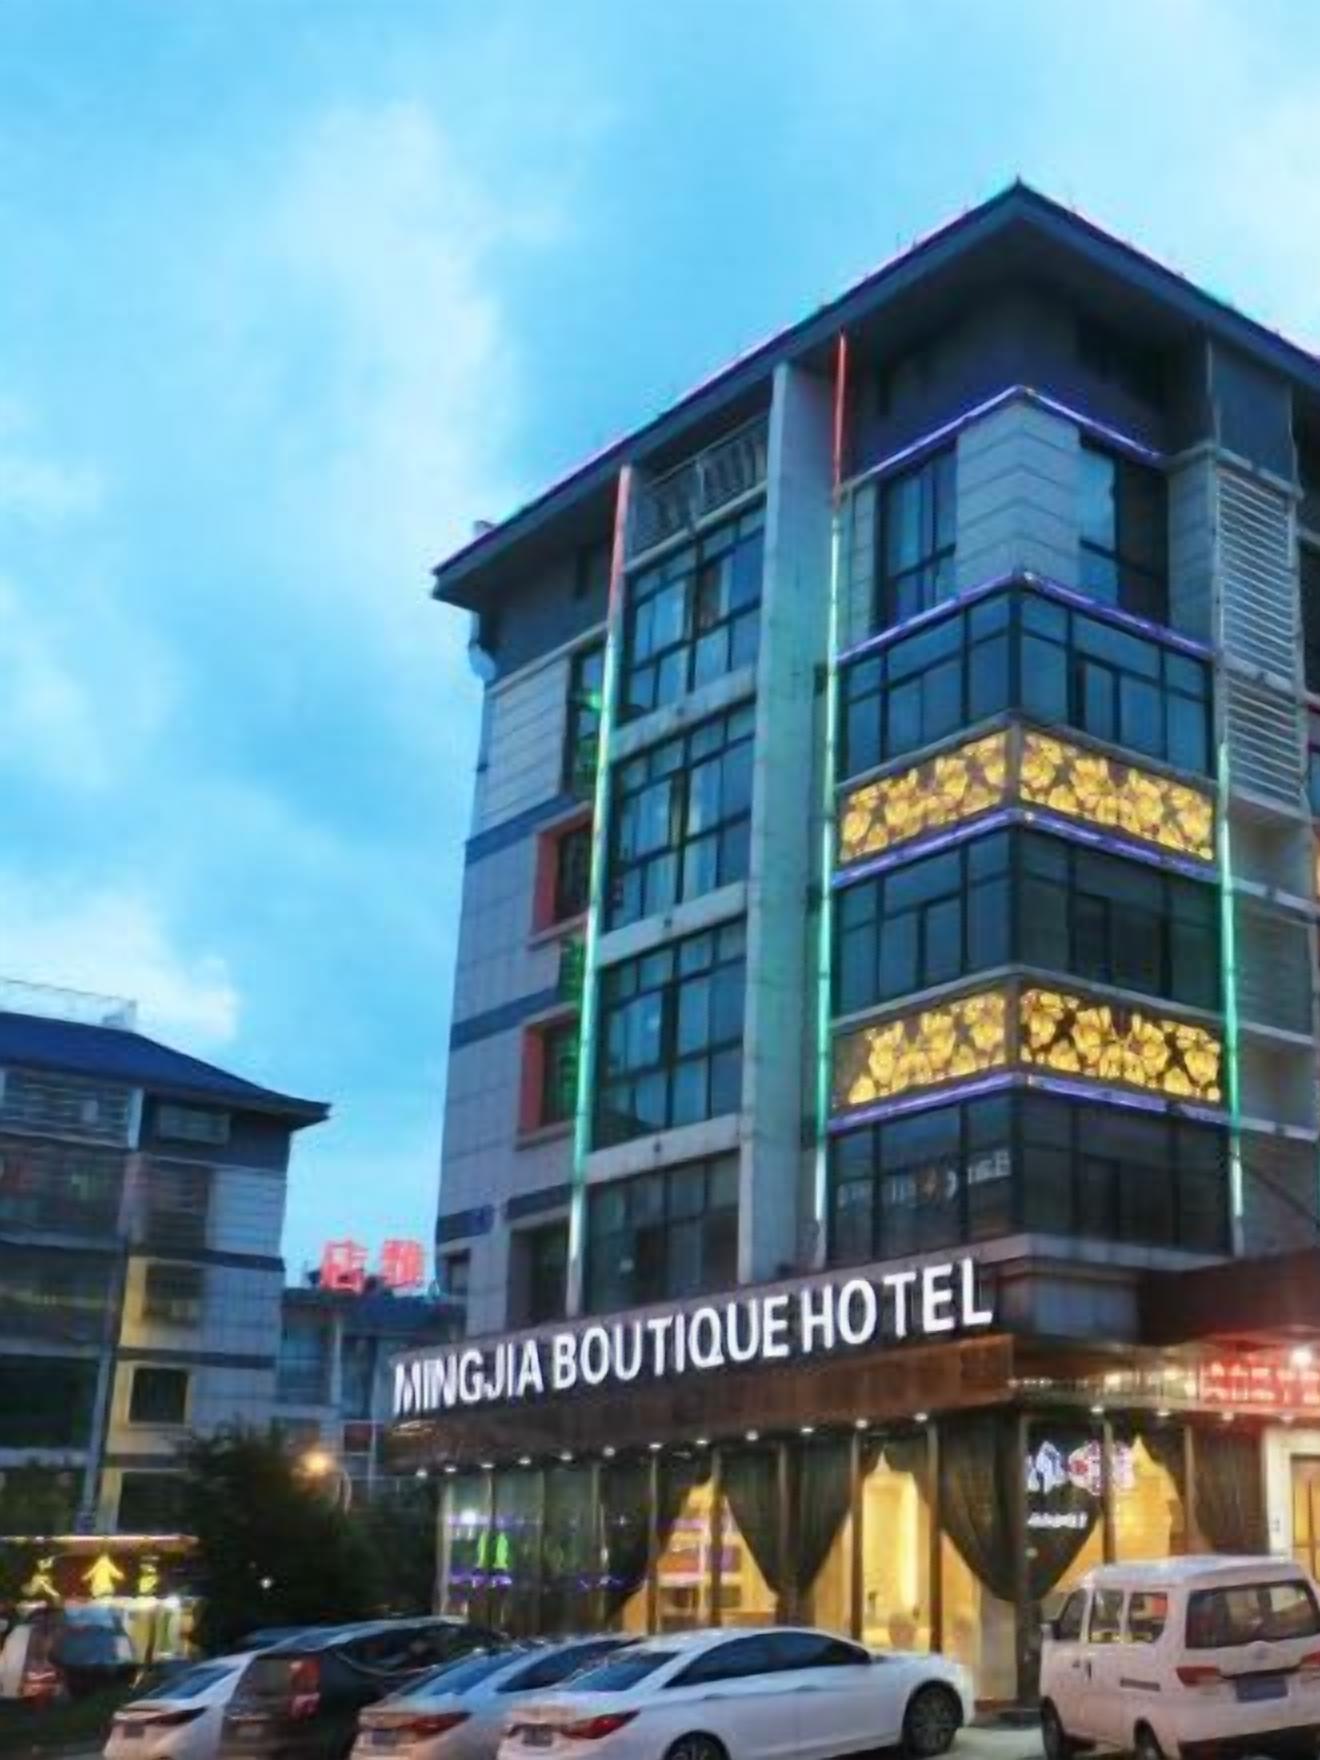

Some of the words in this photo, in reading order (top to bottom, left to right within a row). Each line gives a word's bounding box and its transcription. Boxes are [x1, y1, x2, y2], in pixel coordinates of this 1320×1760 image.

[392, 1339, 544, 1418] MINGJIA
[552, 1294, 790, 1391] BOUTIQUE
[801, 1256, 993, 1353] HOTEL
